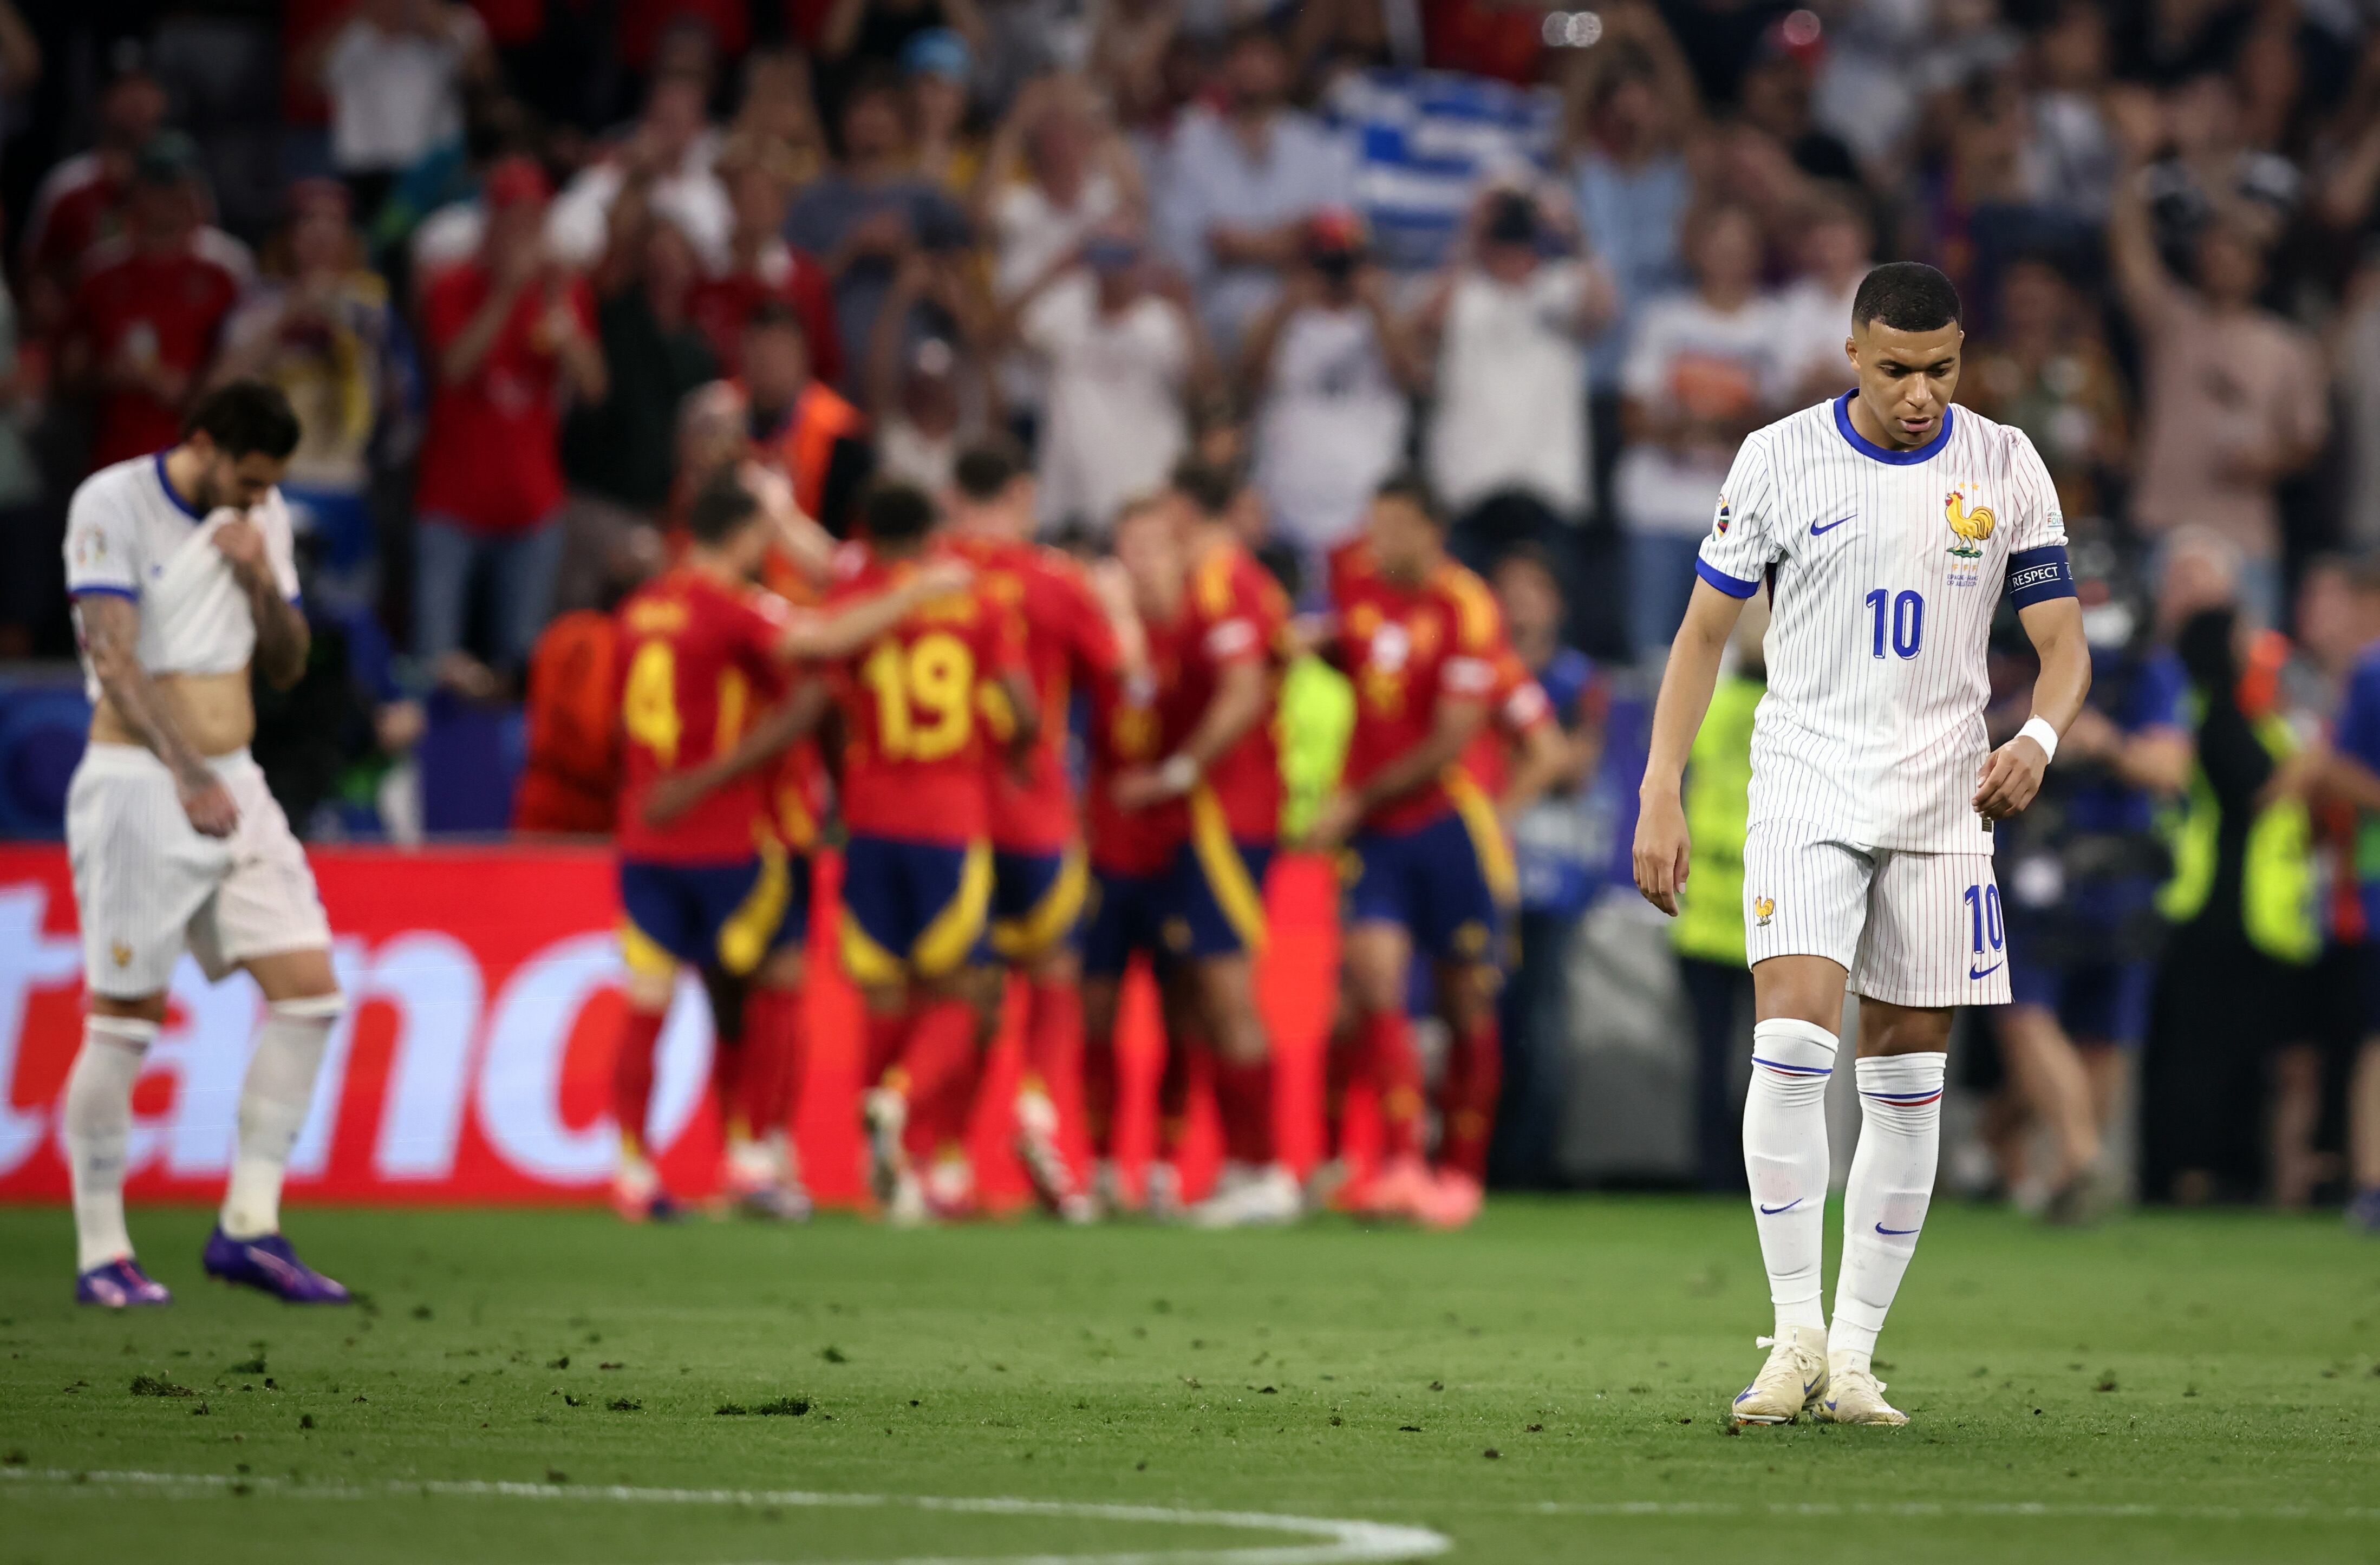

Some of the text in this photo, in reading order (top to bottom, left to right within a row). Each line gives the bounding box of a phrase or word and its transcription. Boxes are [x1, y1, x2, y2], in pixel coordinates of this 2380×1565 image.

[2012, 566, 2058, 588] RESPECT
[1866, 589, 1925, 660] 10
[624, 639, 683, 770] 4
[863, 631, 974, 763] 19
[1965, 884, 2004, 954] 10
